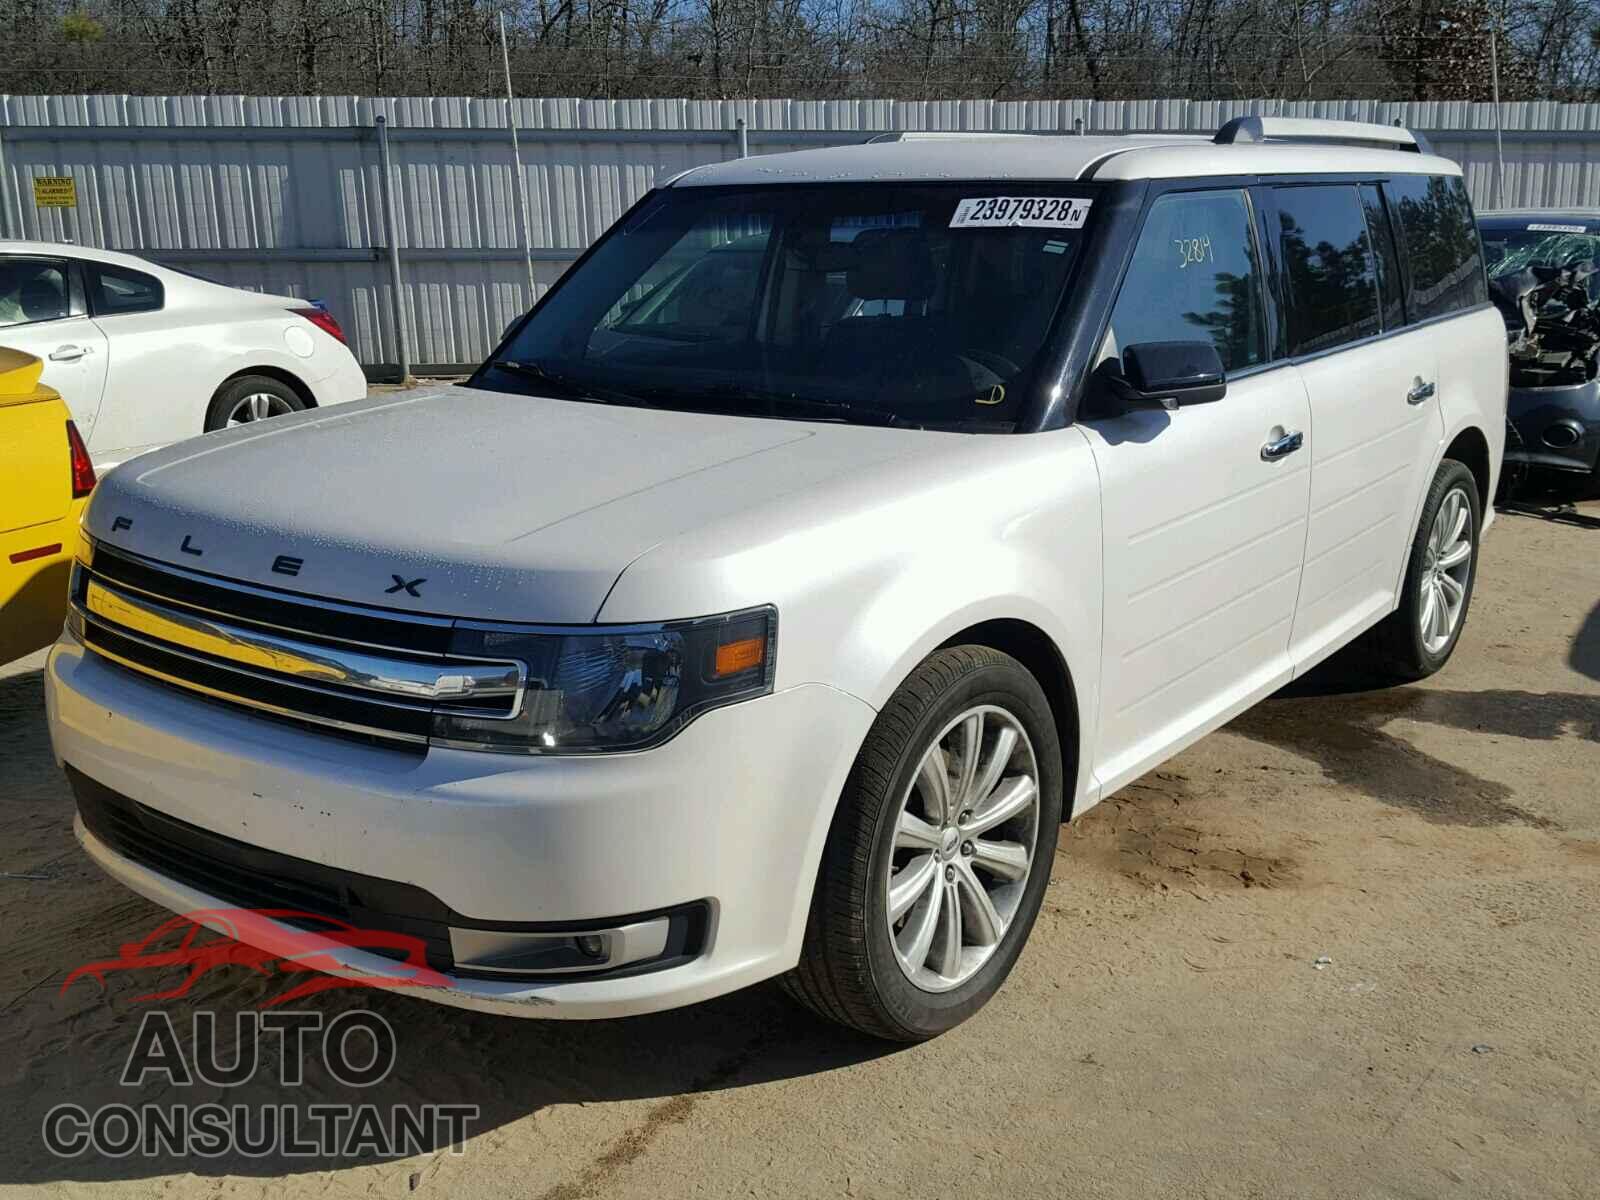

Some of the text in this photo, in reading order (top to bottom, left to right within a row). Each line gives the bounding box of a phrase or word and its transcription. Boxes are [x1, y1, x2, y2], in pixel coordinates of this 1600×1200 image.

[969, 198, 1073, 222] 23979328
[1070, 209, 1082, 222] N
[111, 515, 428, 598] FLEX
